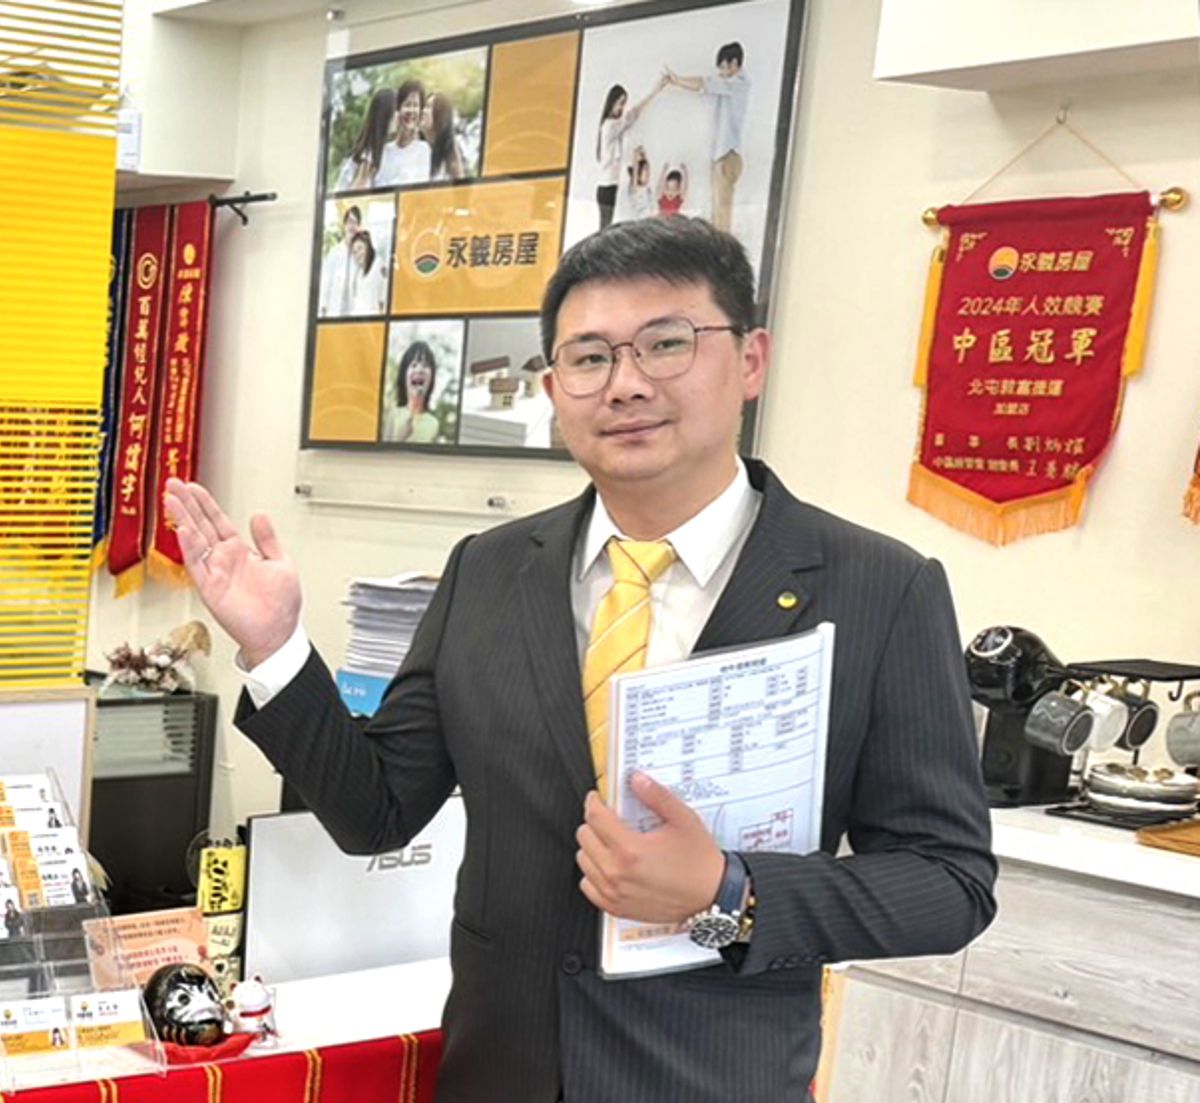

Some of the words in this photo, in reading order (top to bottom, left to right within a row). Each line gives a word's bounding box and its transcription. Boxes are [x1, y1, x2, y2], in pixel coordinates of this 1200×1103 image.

[448, 232, 538, 267] 永義房屋
[1019, 250, 1093, 272] 永義房屋
[953, 327, 1097, 365] 中區冠軍
